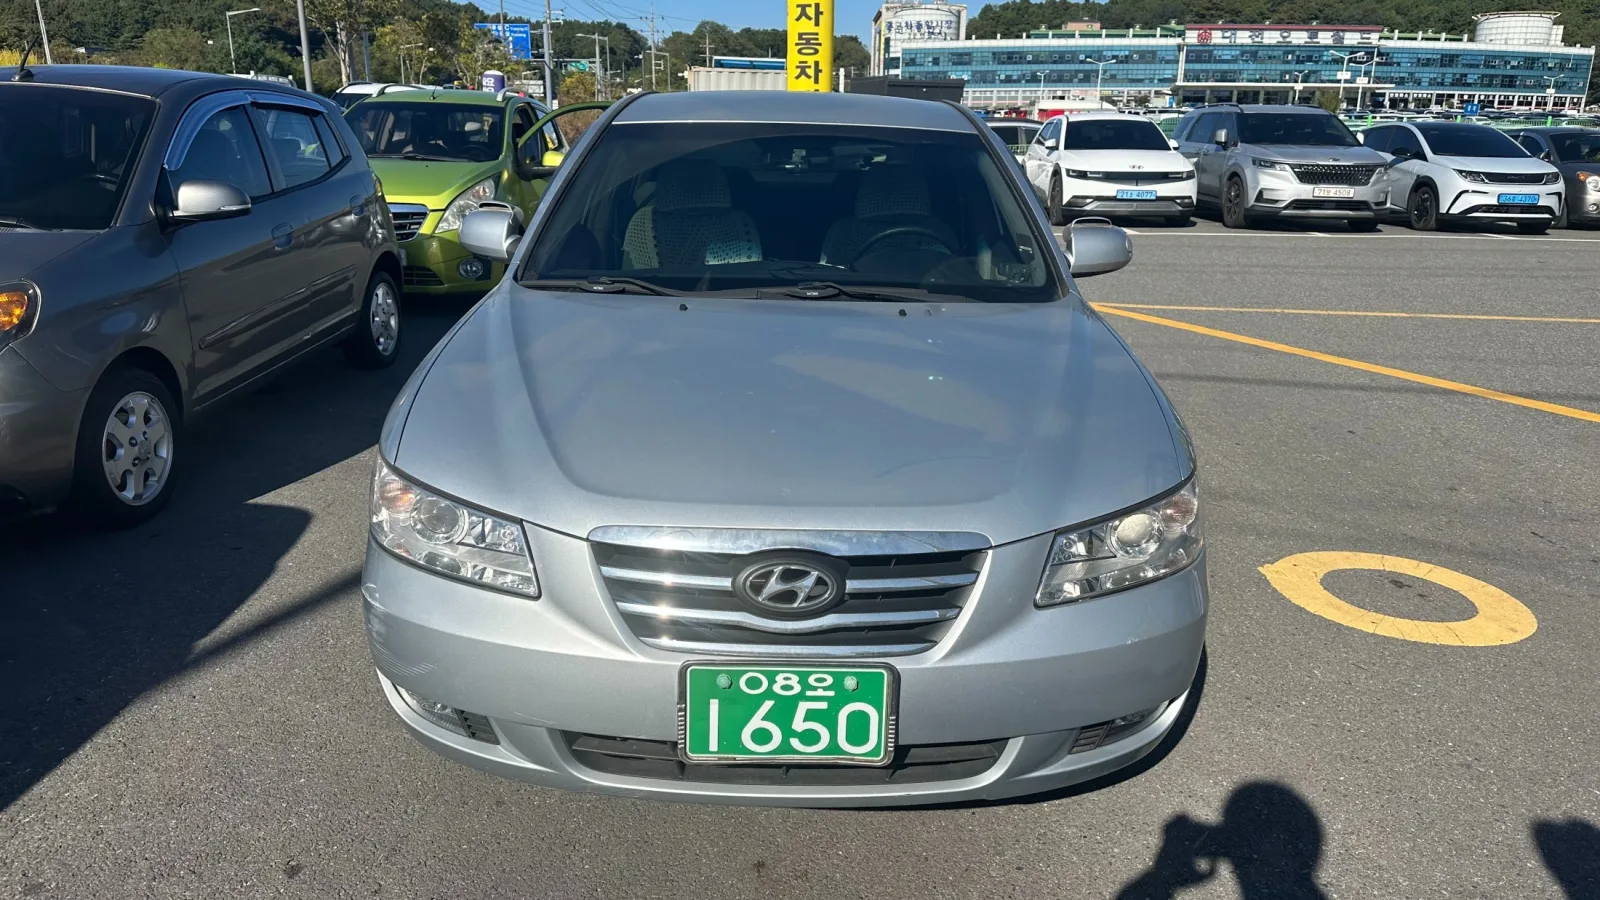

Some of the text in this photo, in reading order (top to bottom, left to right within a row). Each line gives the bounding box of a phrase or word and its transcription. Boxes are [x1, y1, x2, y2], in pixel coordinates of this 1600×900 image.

[794, 2, 824, 85] 자동차
[1221, 29, 1373, 45] 대전오토월드
[739, 671, 835, 697] 08오
[708, 698, 879, 754] 1650
